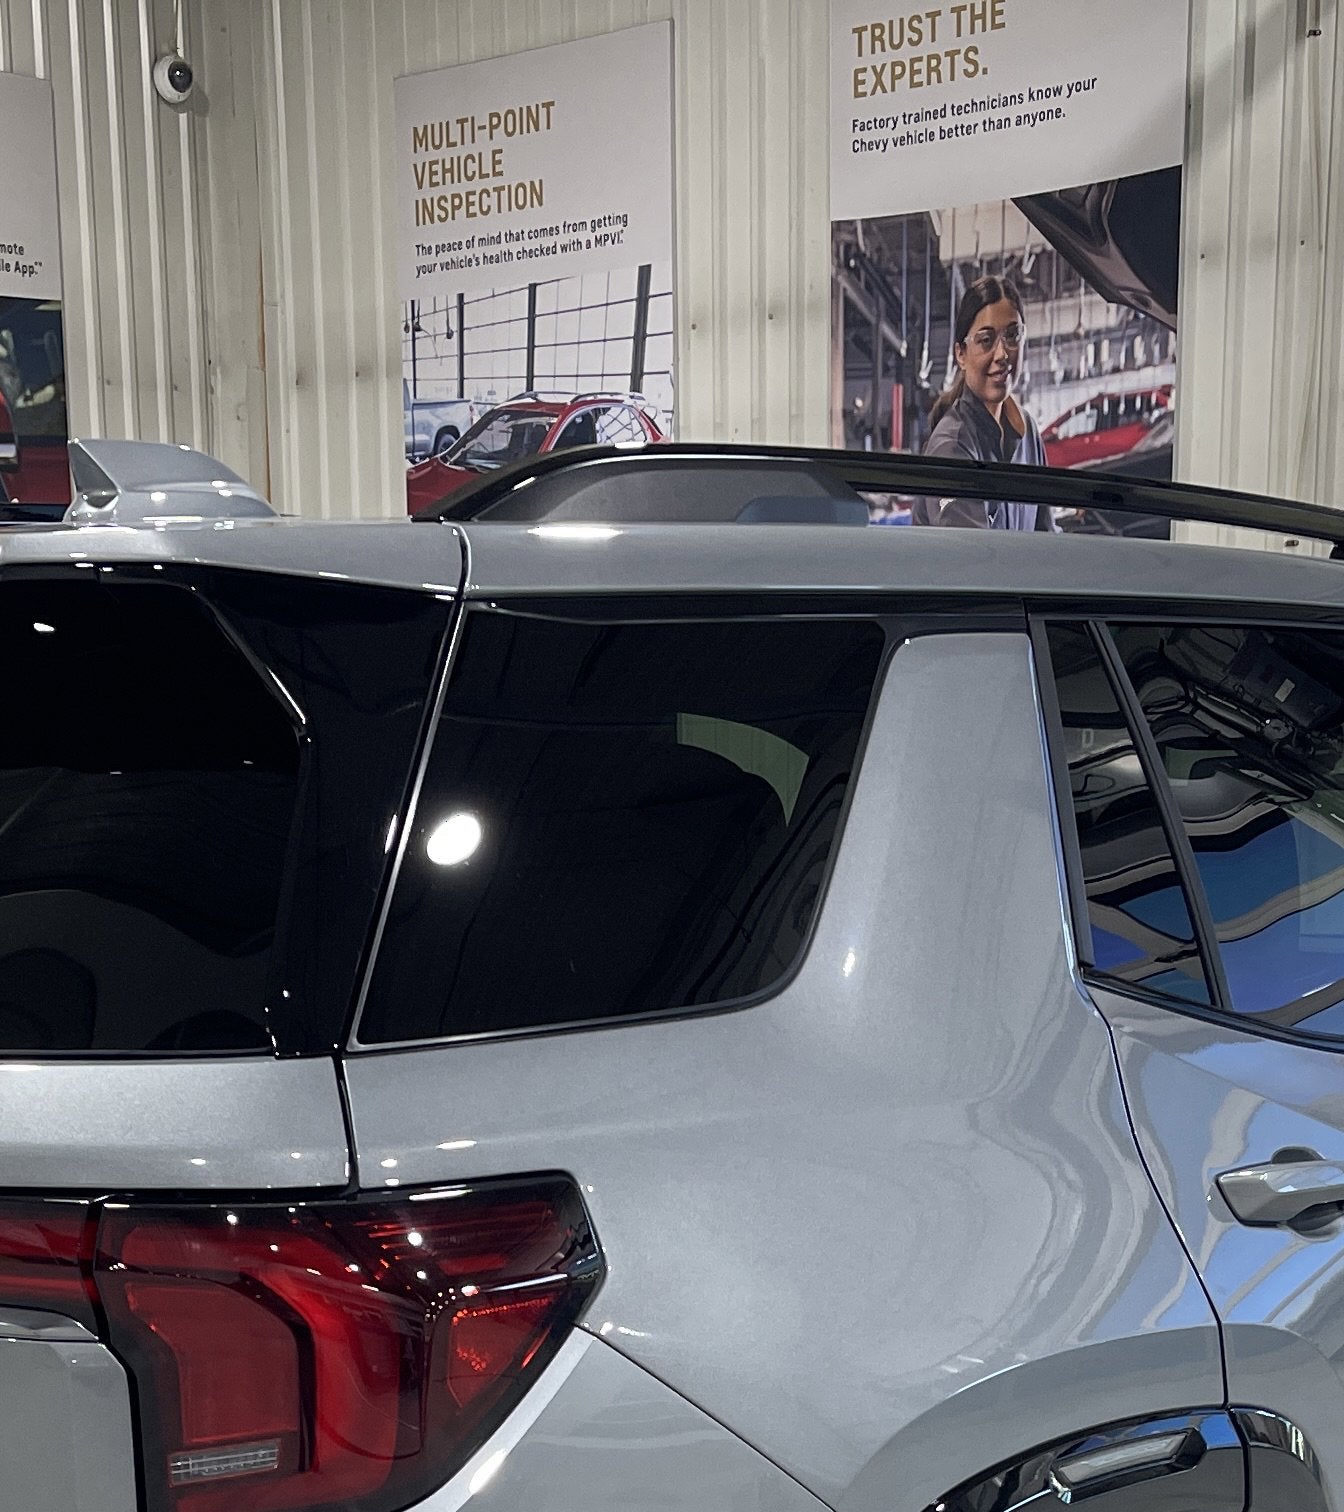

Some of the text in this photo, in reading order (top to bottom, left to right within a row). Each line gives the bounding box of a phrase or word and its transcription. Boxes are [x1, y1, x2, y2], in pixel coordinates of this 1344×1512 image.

[852, 0, 1006, 57] TRUST THE
[853, 45, 988, 99] EXPERTS.
[412, 100, 555, 154] MULTI-POINT
[852, 76, 1098, 134] Factory trained technicians know your
[852, 106, 1066, 153] Chevy vehicle better than anyone.
[413, 148, 504, 190] VEHICLE
[415, 178, 545, 227] INSPECTION
[415, 213, 628, 258] The peace of mind that comes from getting
[416, 262, 437, 279] your
[440, 253, 480, 272] vehicle's
[483, 248, 513, 266] health
[516, 240, 557, 261] checked
[560, 238, 582, 254] with
[585, 239, 592, 250] a
